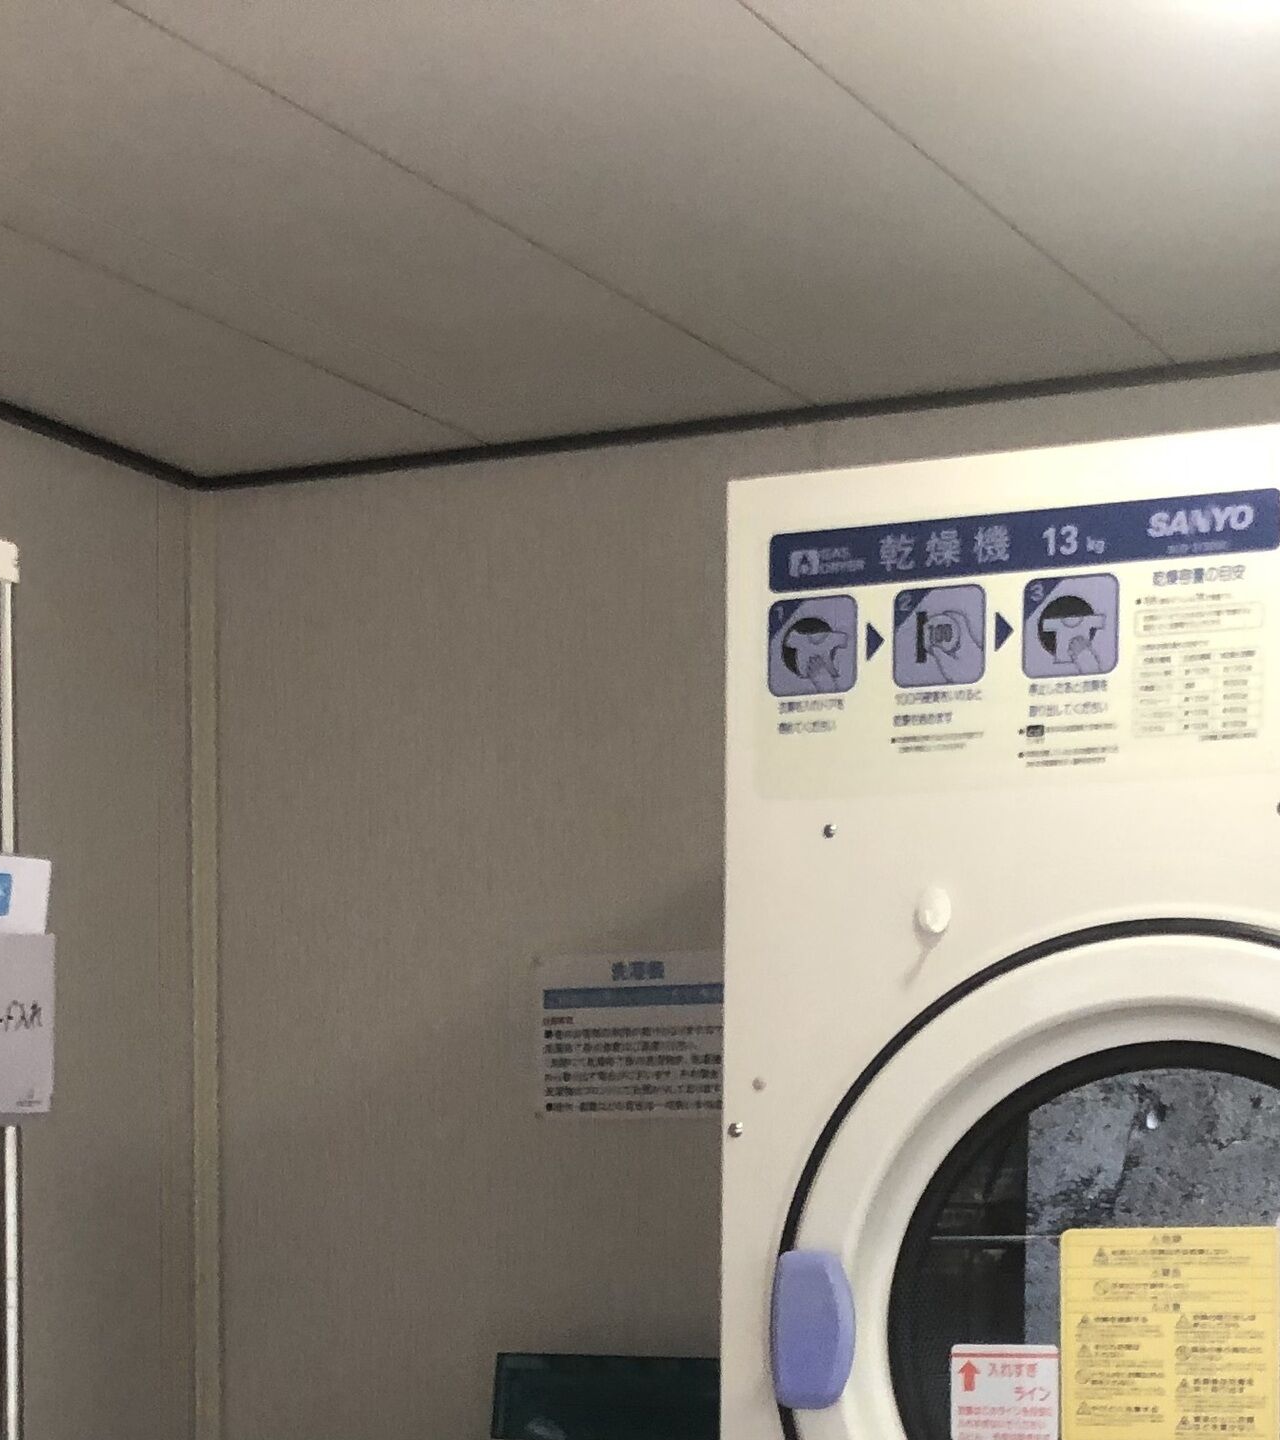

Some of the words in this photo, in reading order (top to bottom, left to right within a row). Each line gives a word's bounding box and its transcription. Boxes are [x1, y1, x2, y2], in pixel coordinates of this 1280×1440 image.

[879, 525, 1011, 572] 乾燥機
[1042, 524, 1079, 556] 13
[1147, 504, 1255, 538] SANYO
[988, 1362, 1038, 1378] 入れすぎ
[1013, 1386, 1051, 1402] ライン
